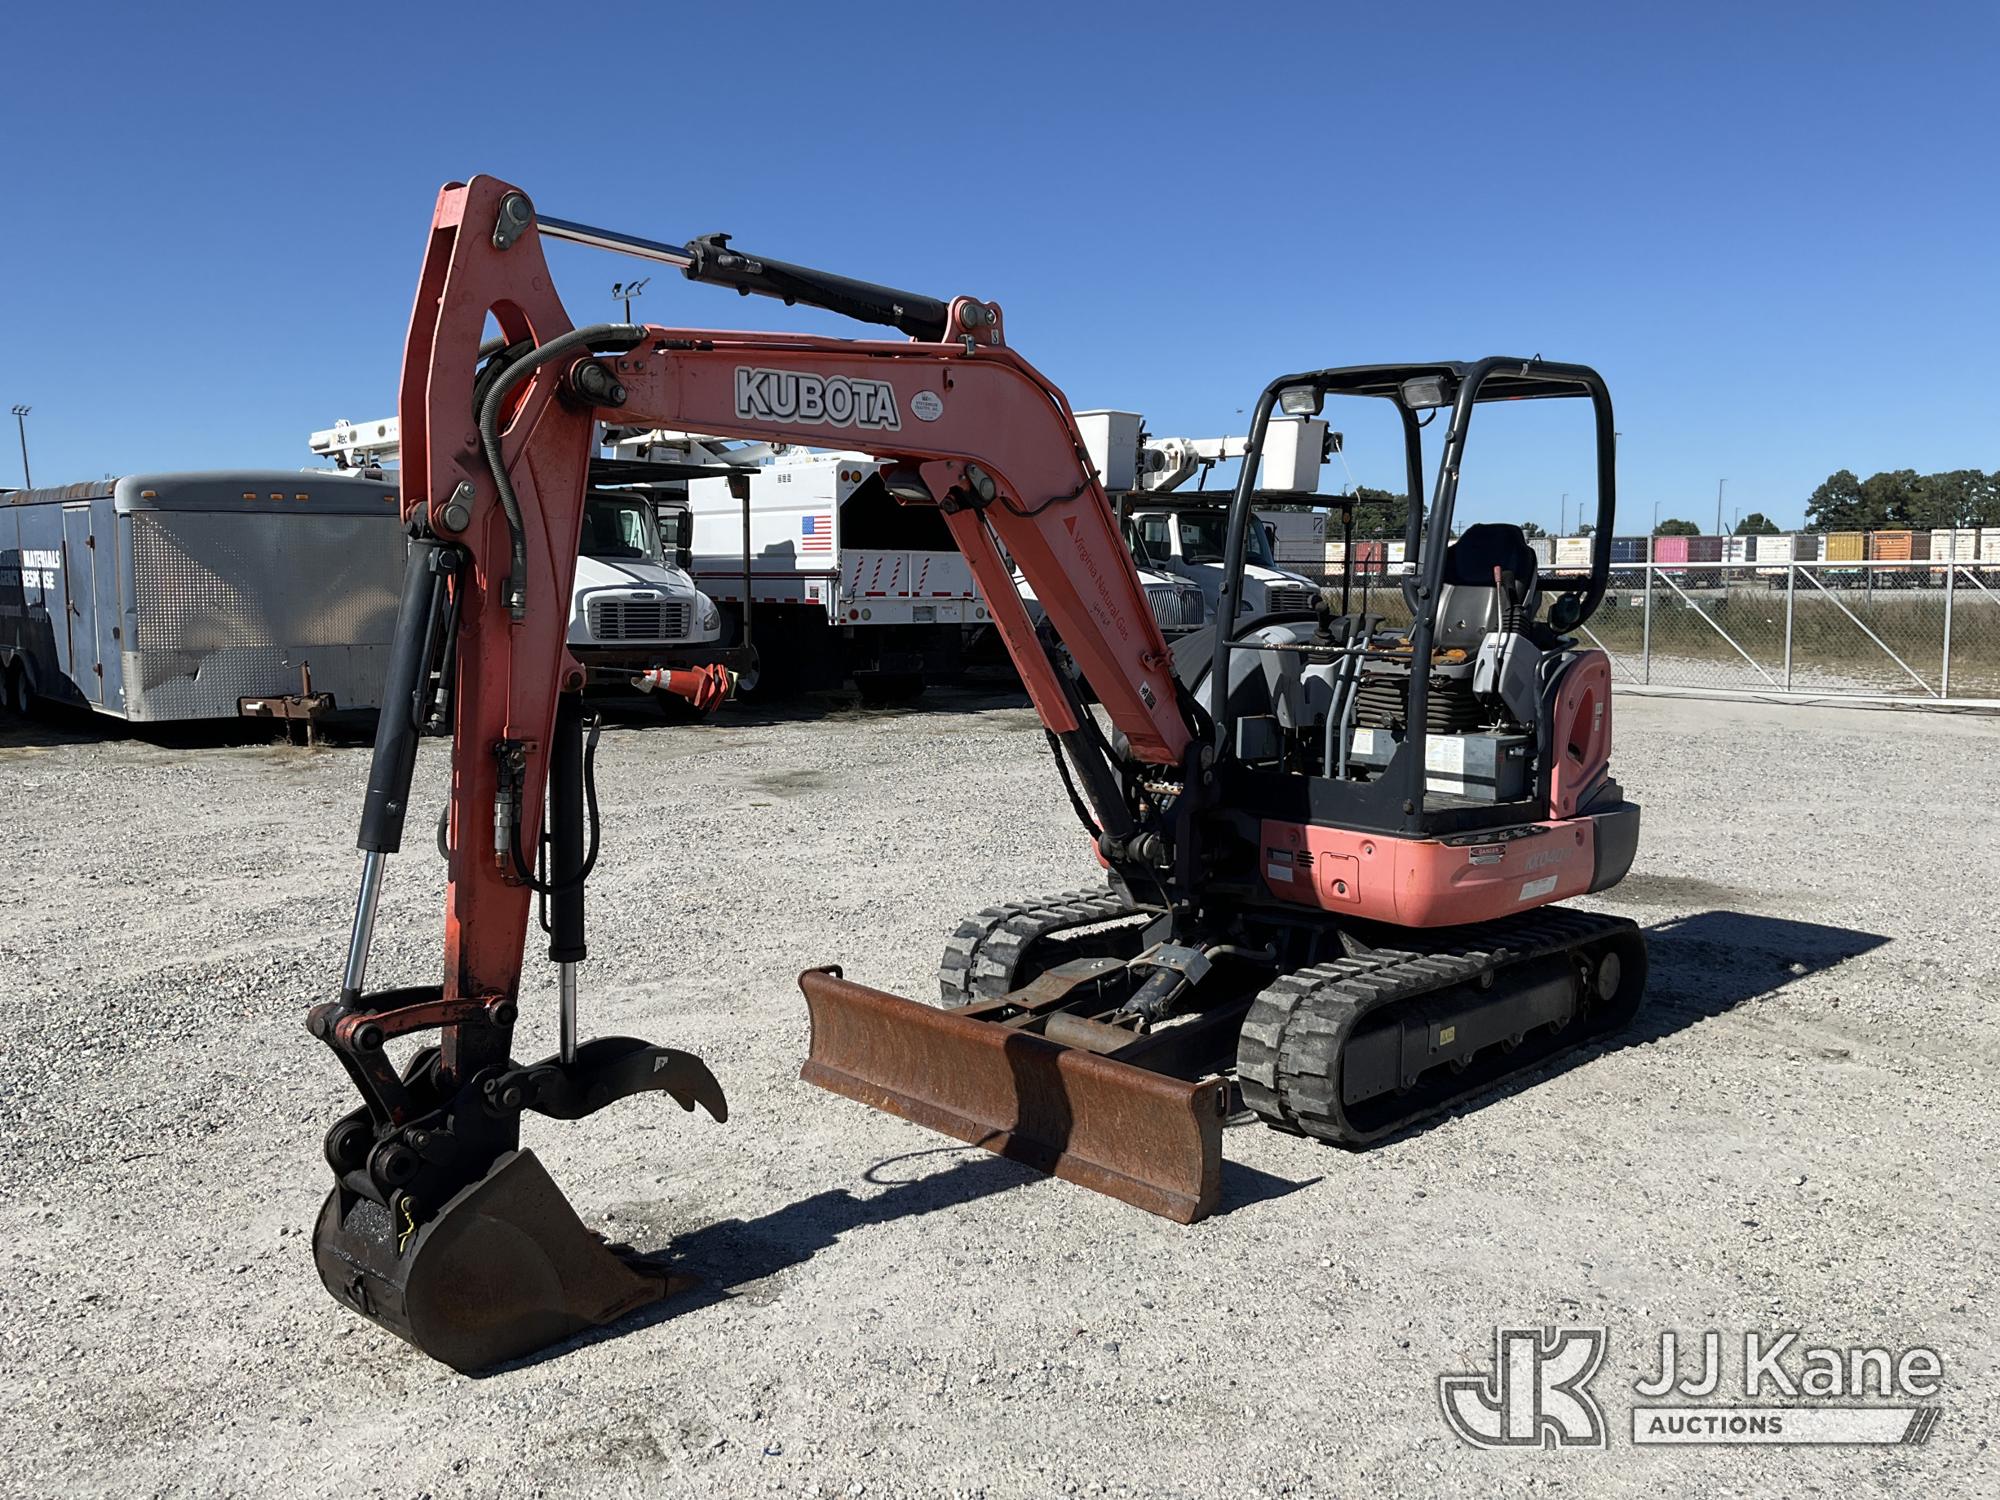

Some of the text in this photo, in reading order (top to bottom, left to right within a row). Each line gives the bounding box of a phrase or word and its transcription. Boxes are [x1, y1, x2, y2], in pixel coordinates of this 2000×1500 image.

[736, 368, 900, 428] KUBOTA
[23, 550, 60, 569] MATERIALS
[22, 570, 55, 590] RESPNSE
[1073, 531, 1097, 578] Virginia
[1095, 575, 1120, 620] Natural
[1115, 616, 1129, 641] Gas
